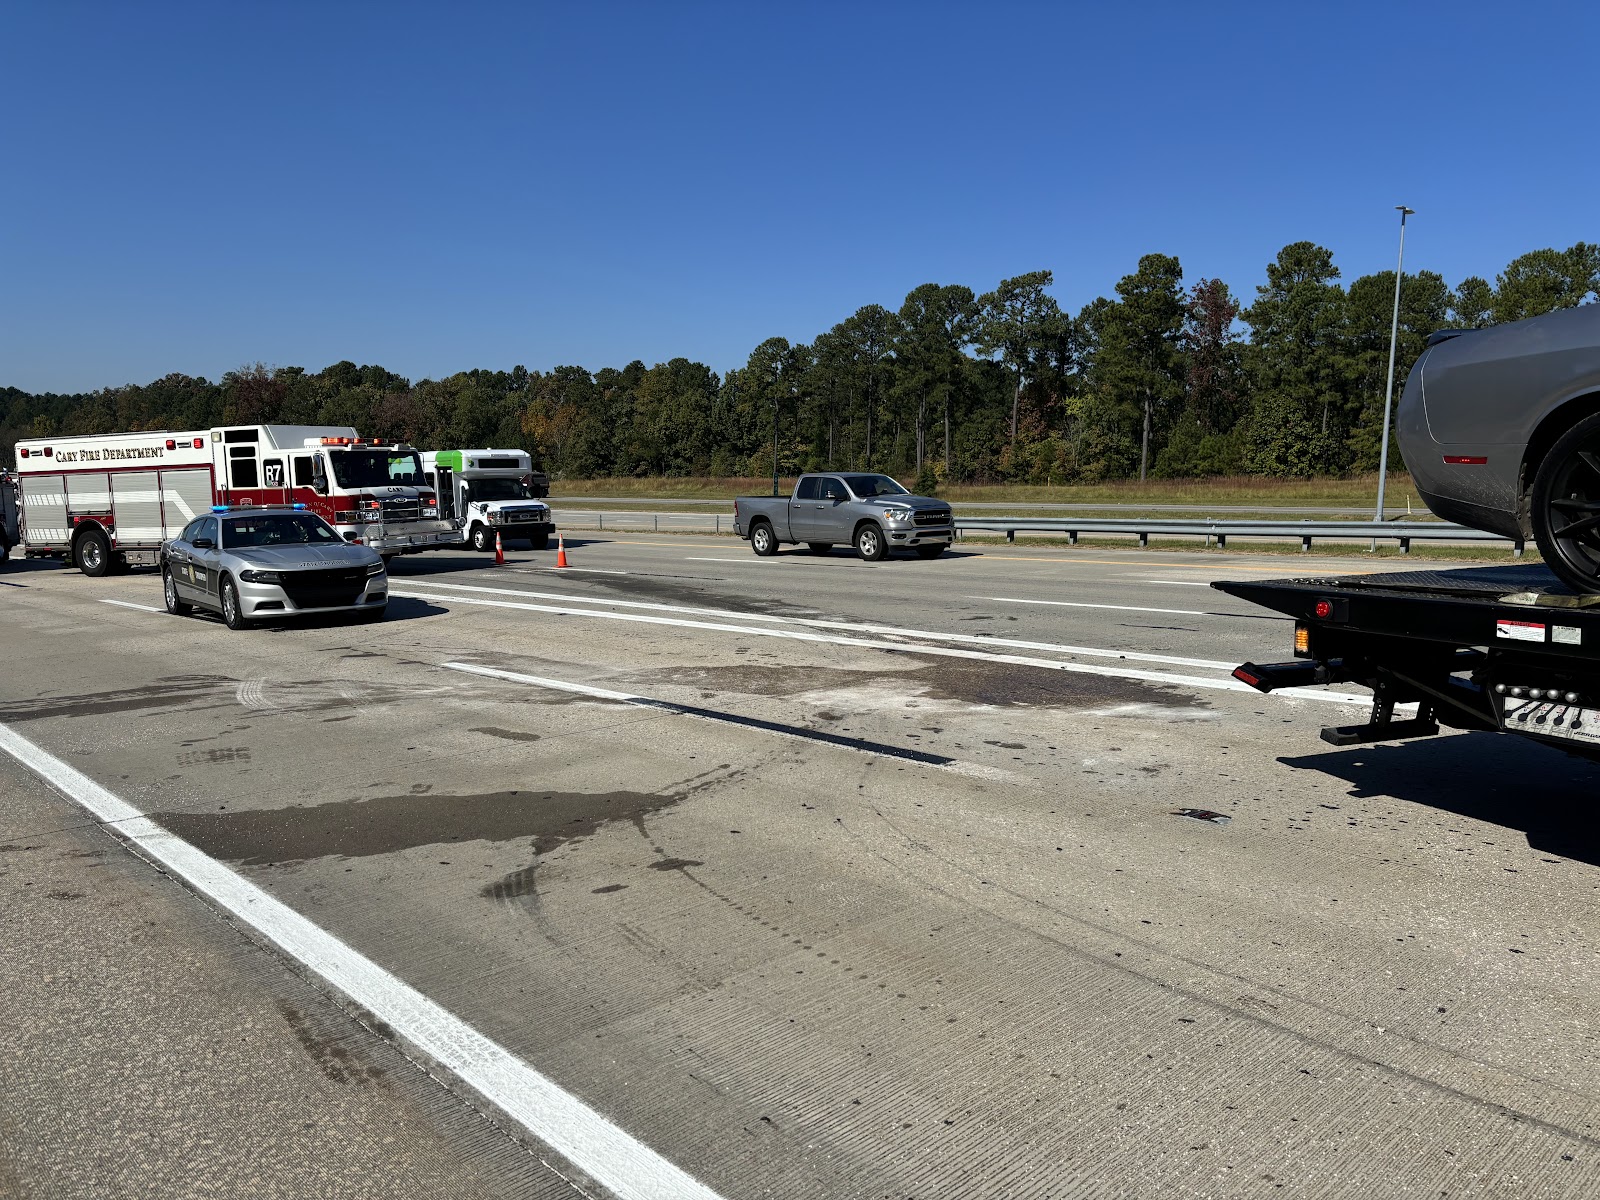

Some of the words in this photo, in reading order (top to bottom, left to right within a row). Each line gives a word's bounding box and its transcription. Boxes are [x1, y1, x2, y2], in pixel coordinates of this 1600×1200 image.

[55, 450, 78, 462] CARY
[79, 449, 101, 462] FIRE
[102, 446, 164, 461] DEPARTMENT
[265, 464, 281, 481] R7
